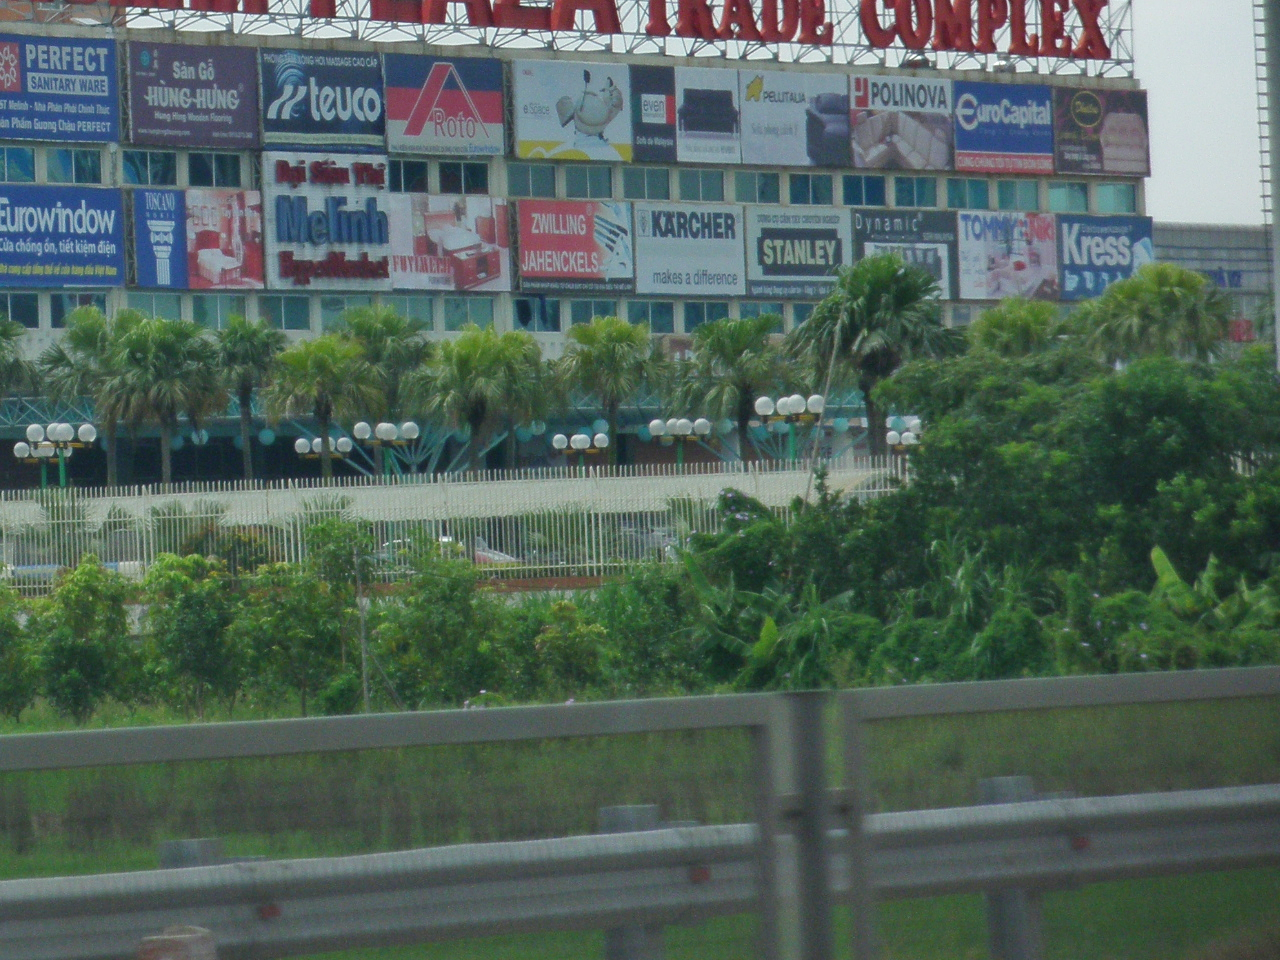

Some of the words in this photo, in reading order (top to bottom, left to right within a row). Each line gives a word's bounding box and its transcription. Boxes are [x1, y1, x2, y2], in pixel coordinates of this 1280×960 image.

[25, 44, 108, 72] PERFECT
[172, 60, 195, 79] Sàn
[198, 58, 215, 80] Gỗ
[31, 76, 76, 92] SANITARY
[78, 78, 106, 93] WARE
[871, 81, 947, 109] POLINOVA
[309, 76, 381, 122] teuco
[643, 98, 666, 113] even
[77, 120, 111, 132] PERFECT
[433, 108, 476, 138] Roto
[145, 192, 175, 211] TOSCANO
[531, 212, 587, 236] ZWILLING
[651, 210, 736, 240] KÄRCHER
[855, 213, 919, 233] Dynamic
[15, 237, 43, 257] chống
[75, 239, 96, 257] kiệm
[97, 240, 116, 258] điện
[763, 239, 836, 266] STANLEY
[1062, 222, 1132, 266] Kress
[653, 269, 683, 285] makes
[685, 272, 691, 285] a
[693, 269, 738, 286] difference
